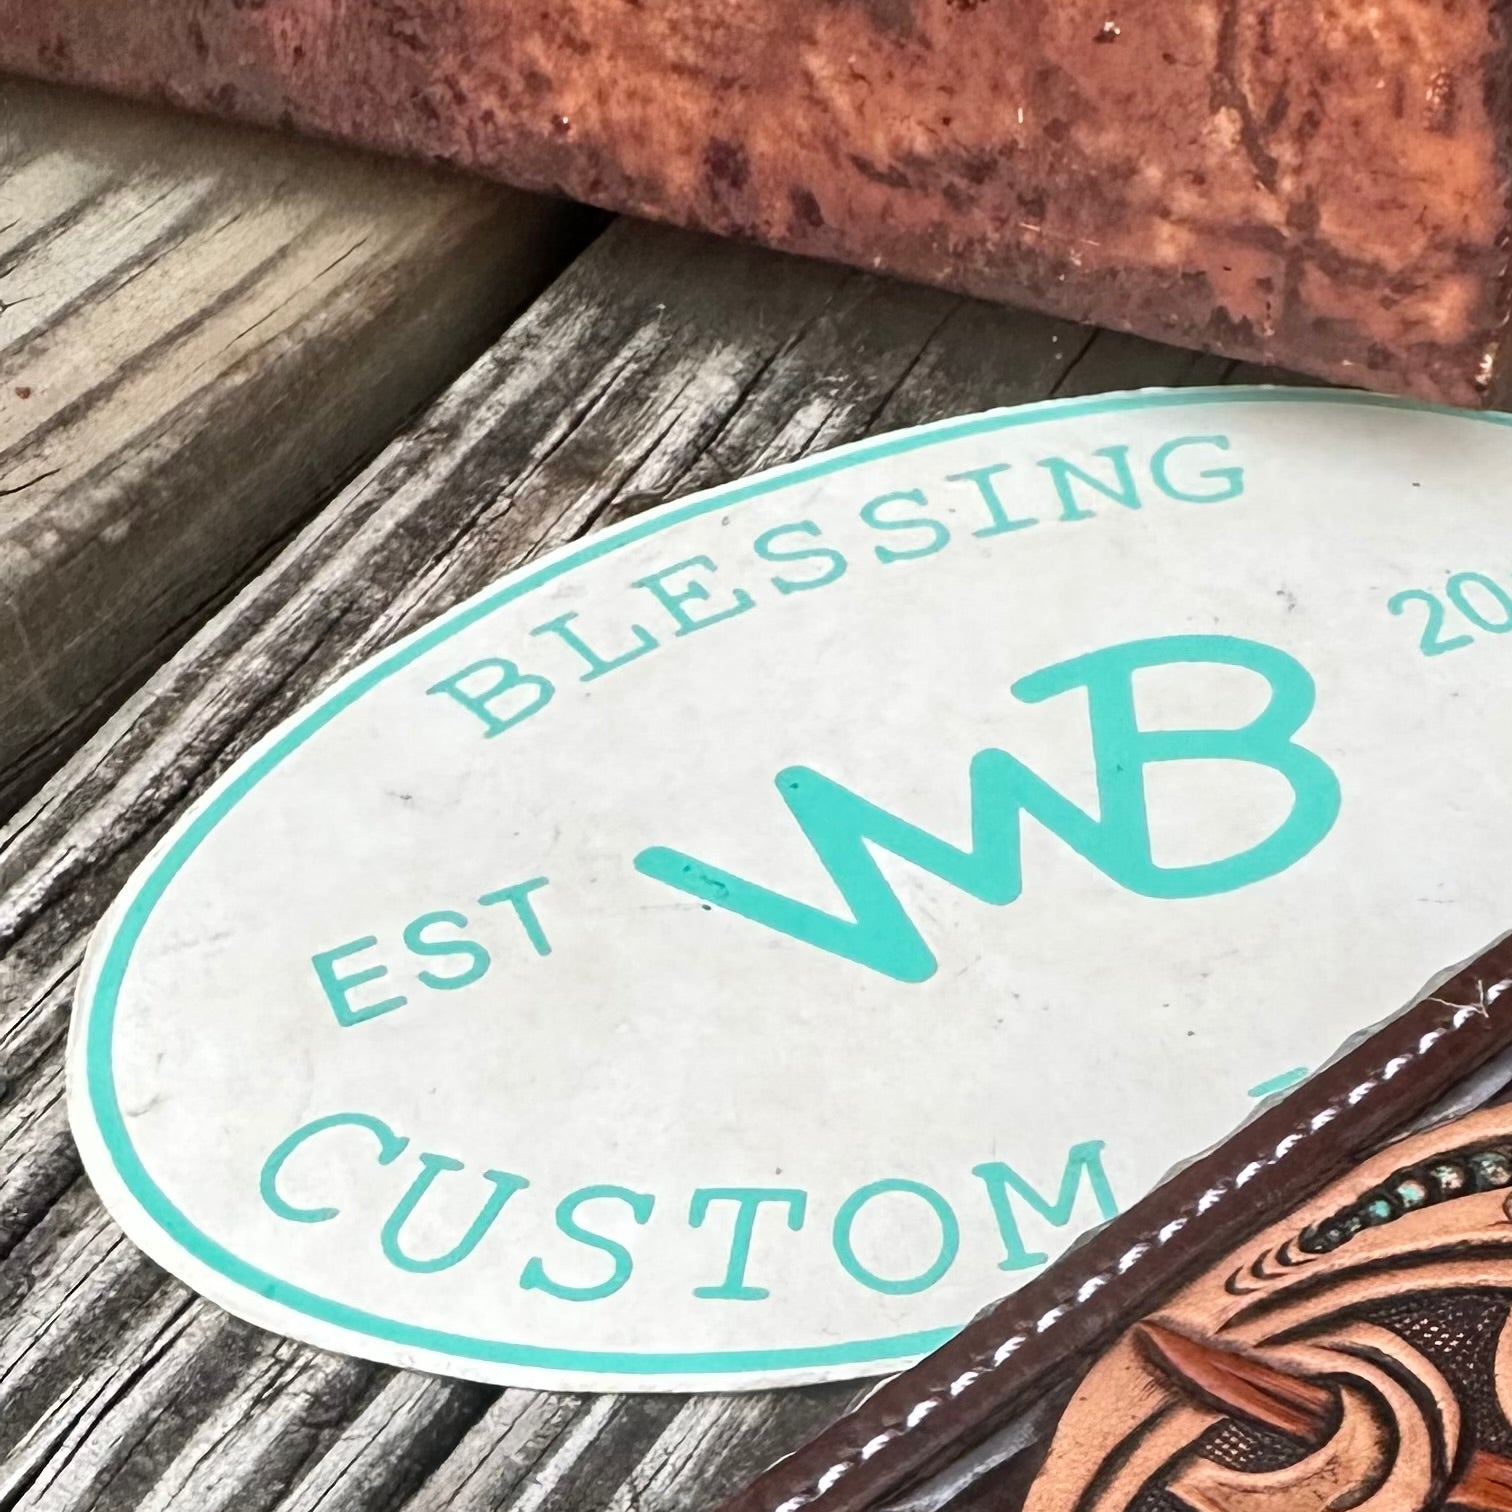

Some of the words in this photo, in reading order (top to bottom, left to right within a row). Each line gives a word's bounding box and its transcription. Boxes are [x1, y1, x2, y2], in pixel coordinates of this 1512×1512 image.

[430, 437, 1245, 738] BLESSING
[312, 877, 550, 1027] EST
[259, 1112, 1120, 1302] CUSTOM
